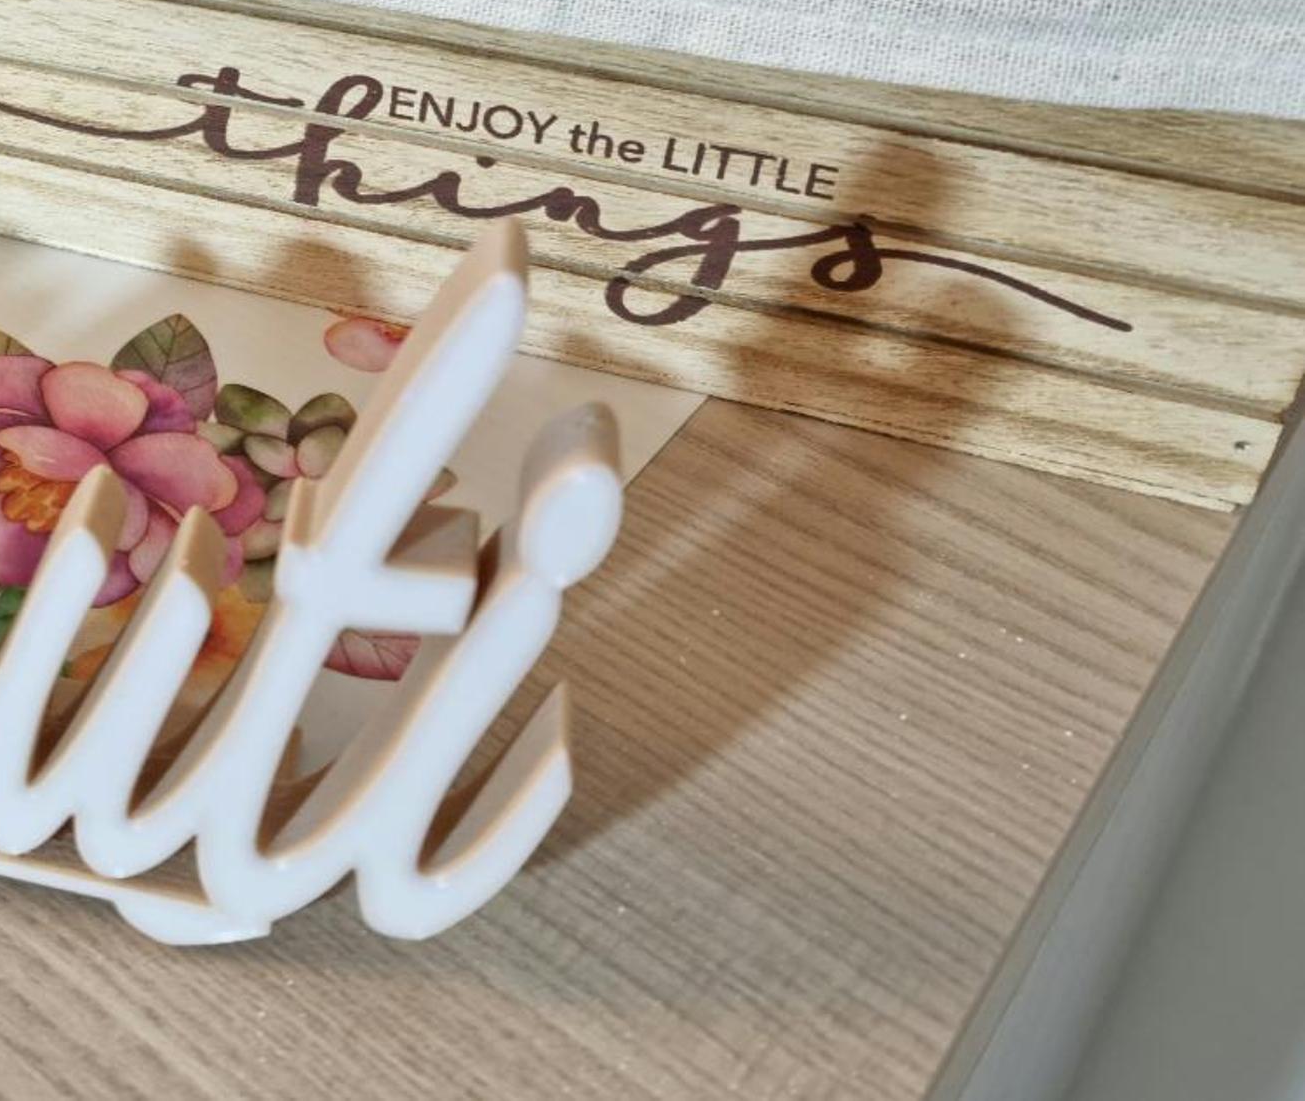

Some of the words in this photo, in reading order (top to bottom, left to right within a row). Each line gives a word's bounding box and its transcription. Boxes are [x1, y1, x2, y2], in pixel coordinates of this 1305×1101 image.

[389, 86, 558, 144] ENJOY
[568, 121, 646, 163] the
[662, 137, 840, 200] LITTLE
